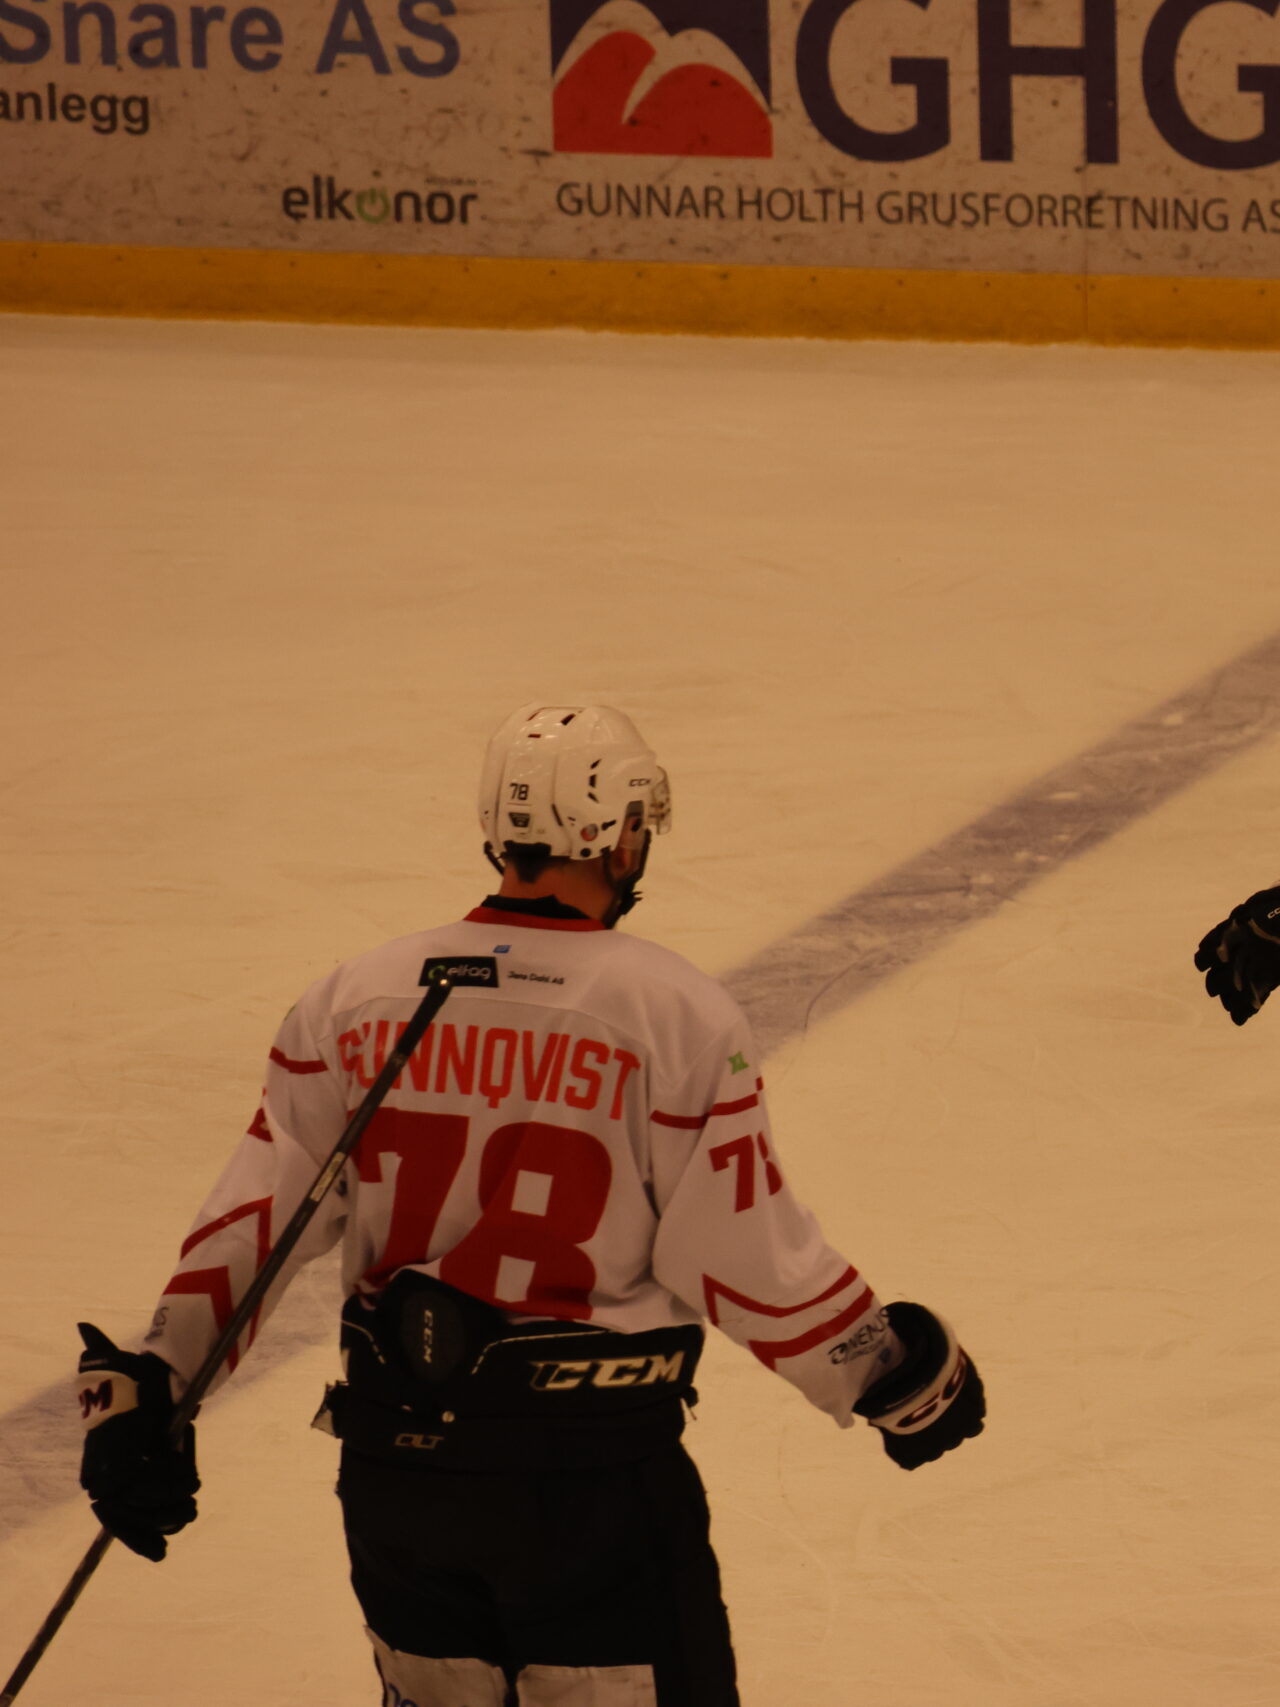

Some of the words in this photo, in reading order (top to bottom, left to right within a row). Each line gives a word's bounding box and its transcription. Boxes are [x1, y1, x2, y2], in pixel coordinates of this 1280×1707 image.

[315, 0, 460, 78] AS
[557, 181, 725, 220] GUNNAR
[737, 187, 864, 225] HOLTH
[877, 190, 1230, 233] GRUSFORRETNING
[509, 783, 529, 800] 78
[346, 1106, 613, 1320] 78
[423, 1309, 434, 1364] CCM
[527, 1350, 686, 1392] CCM
